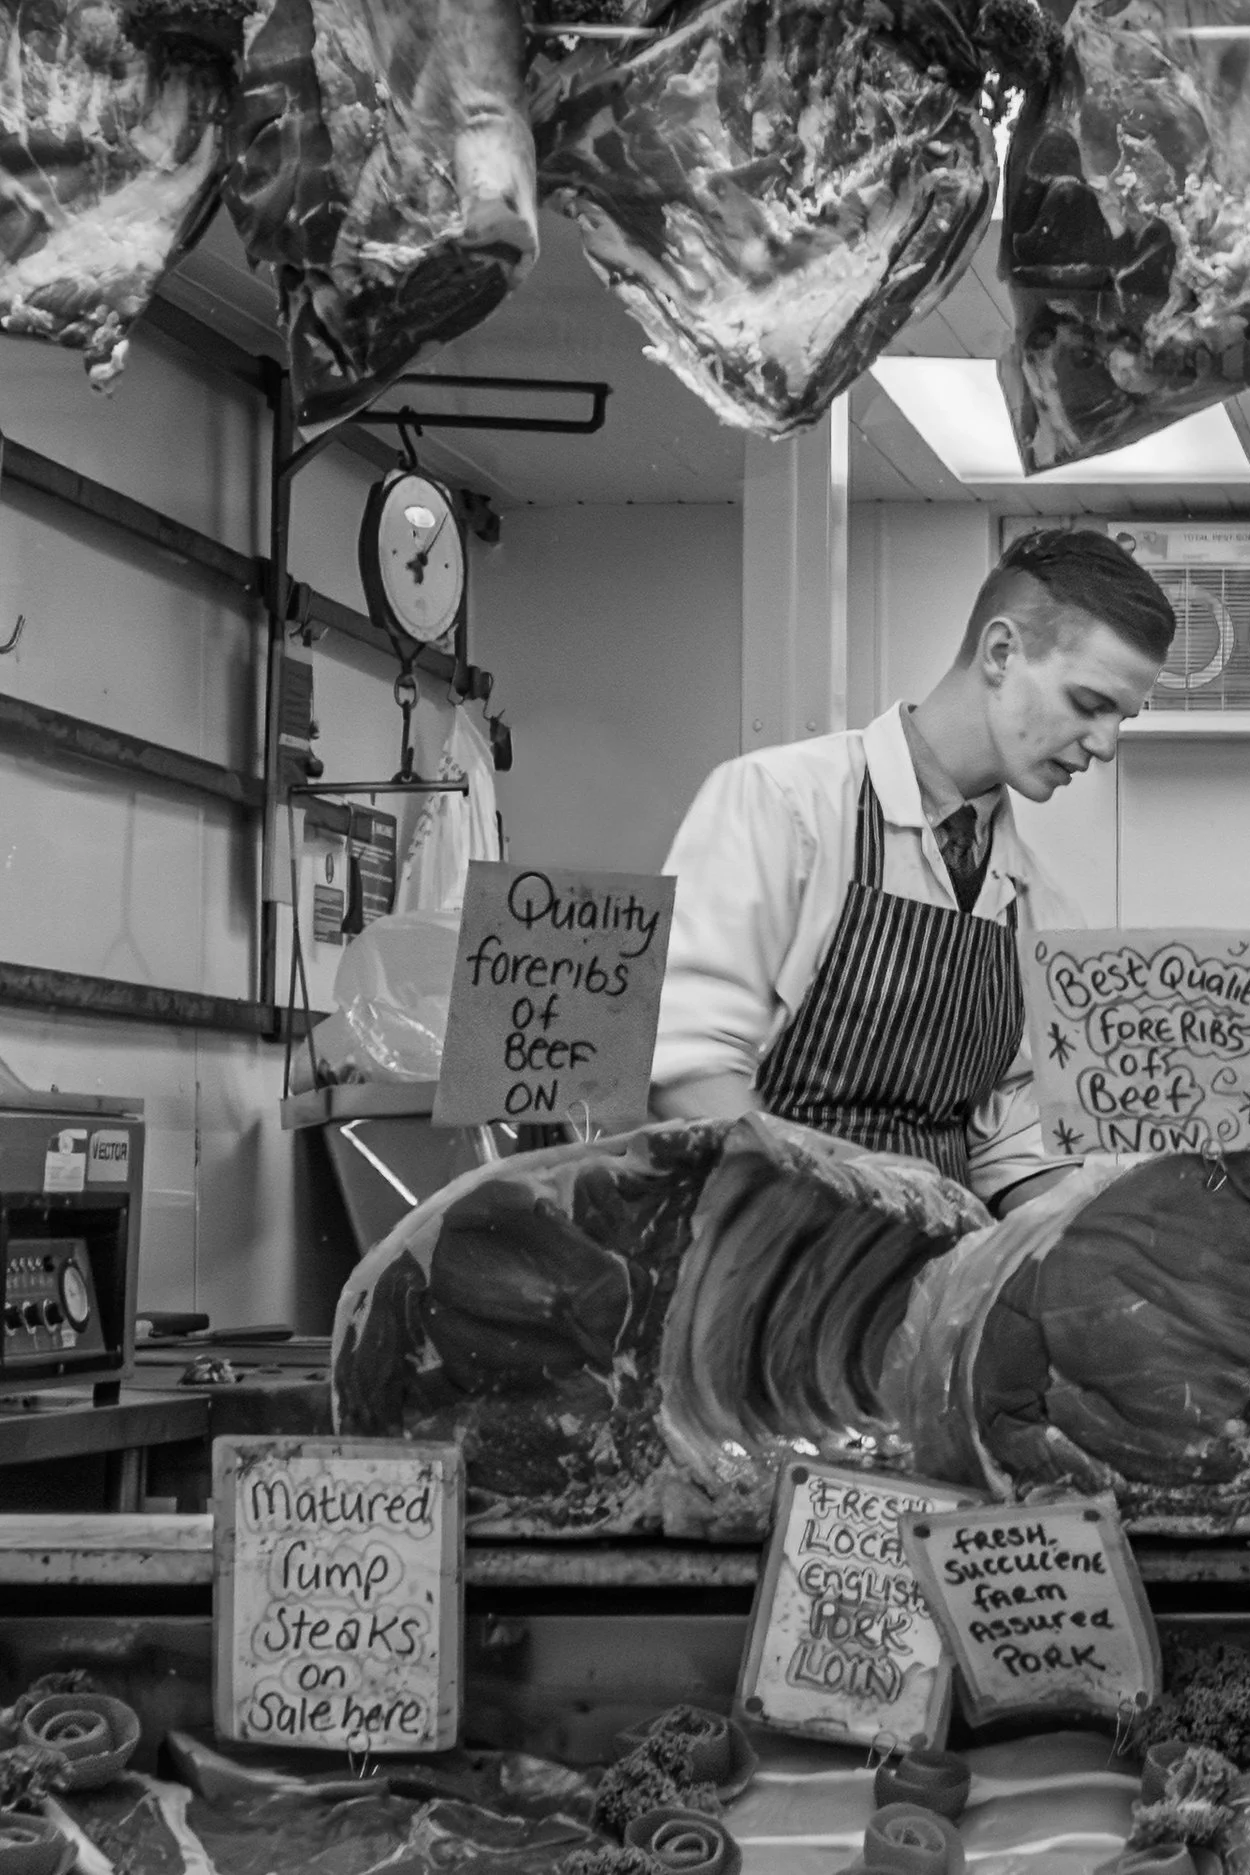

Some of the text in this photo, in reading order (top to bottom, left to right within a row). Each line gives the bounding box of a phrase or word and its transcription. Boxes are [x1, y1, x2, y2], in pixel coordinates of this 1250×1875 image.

[508, 871, 660, 957] Quality
[466, 935, 628, 996] foreribs
[1055, 957, 1147, 1008] Best
[1089, 1072, 1192, 1113] Beef
[92, 1141, 128, 1161] VECTOR
[1107, 1118, 1199, 1152] NOW
[251, 1478, 430, 1524] Matured
[803, 1518, 903, 1563] LOCA
[283, 1540, 389, 1600] rump
[264, 1606, 421, 1655] Steaks
[299, 1663, 345, 1692] on
[991, 1644, 1107, 1678] PORK
[248, 1690, 421, 1736] Sale here
